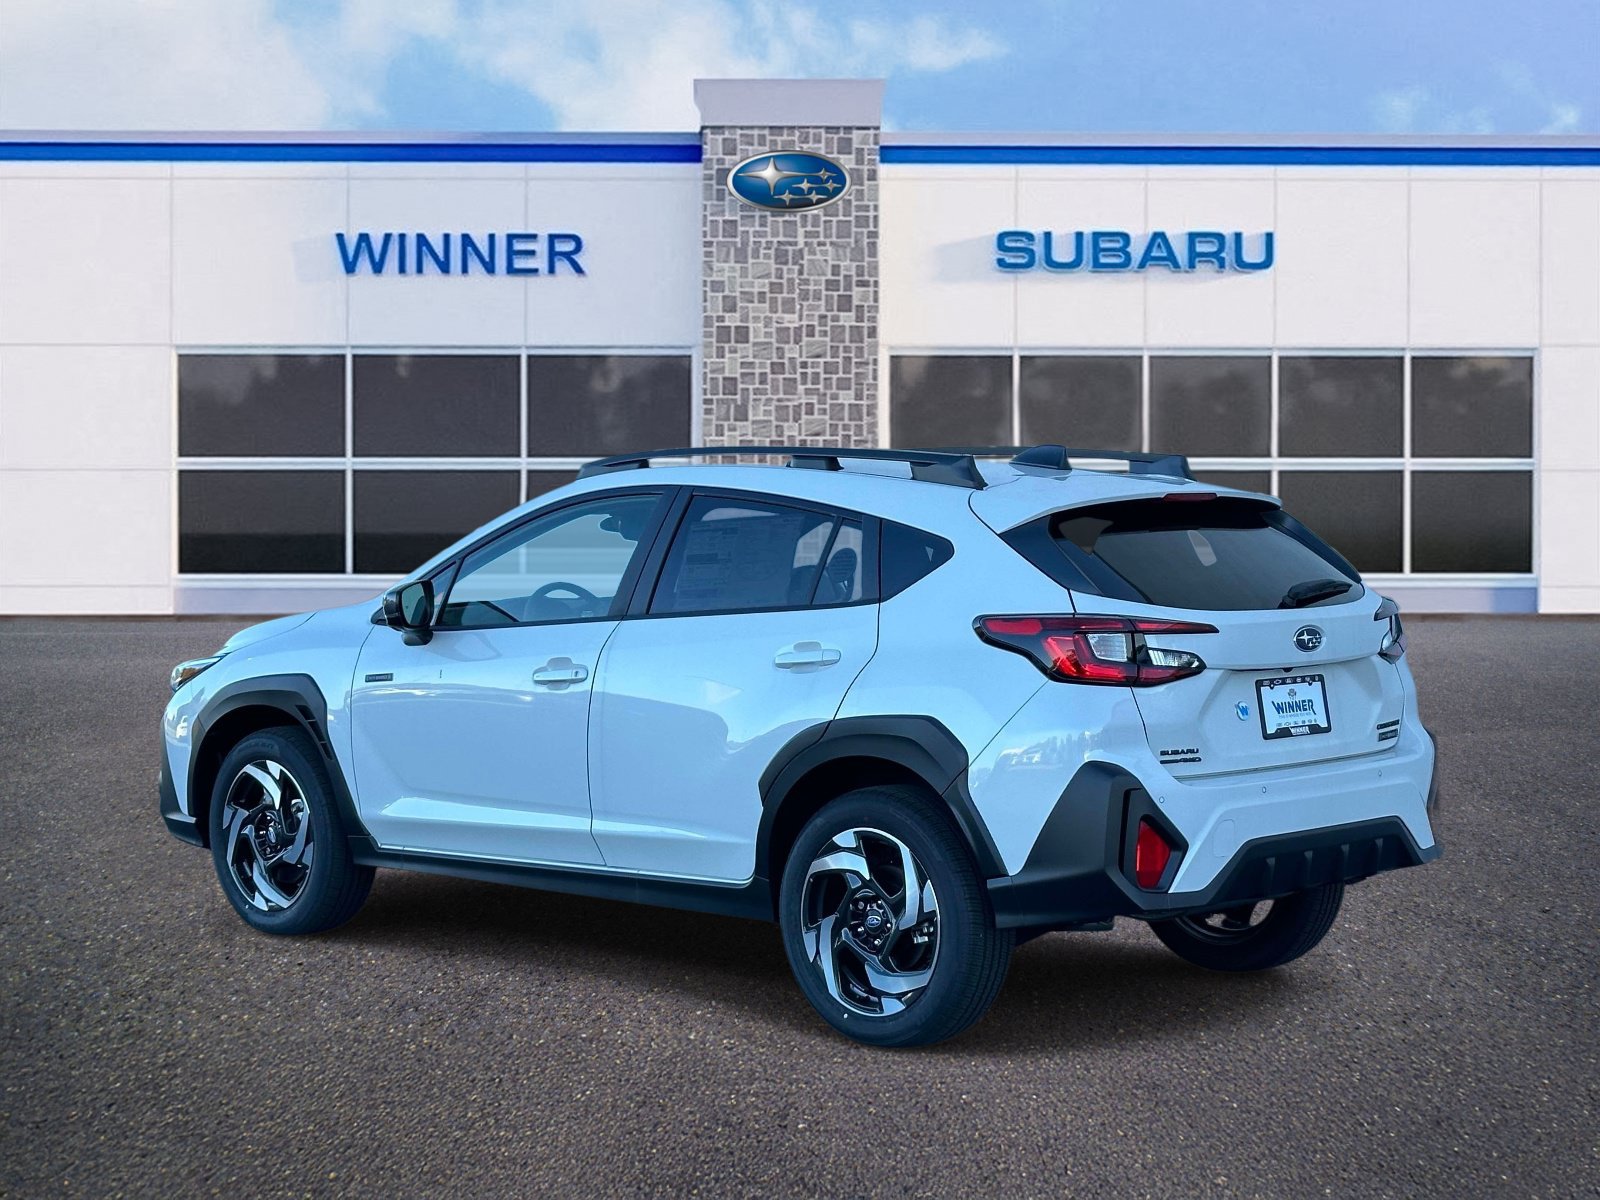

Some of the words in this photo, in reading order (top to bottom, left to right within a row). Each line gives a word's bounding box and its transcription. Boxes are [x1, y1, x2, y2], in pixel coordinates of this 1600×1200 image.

[336, 232, 586, 275] WINNER
[996, 230, 1275, 271] SUBARU
[1271, 699, 1317, 715] WINNER
[1160, 748, 1199, 756] SUBARU
